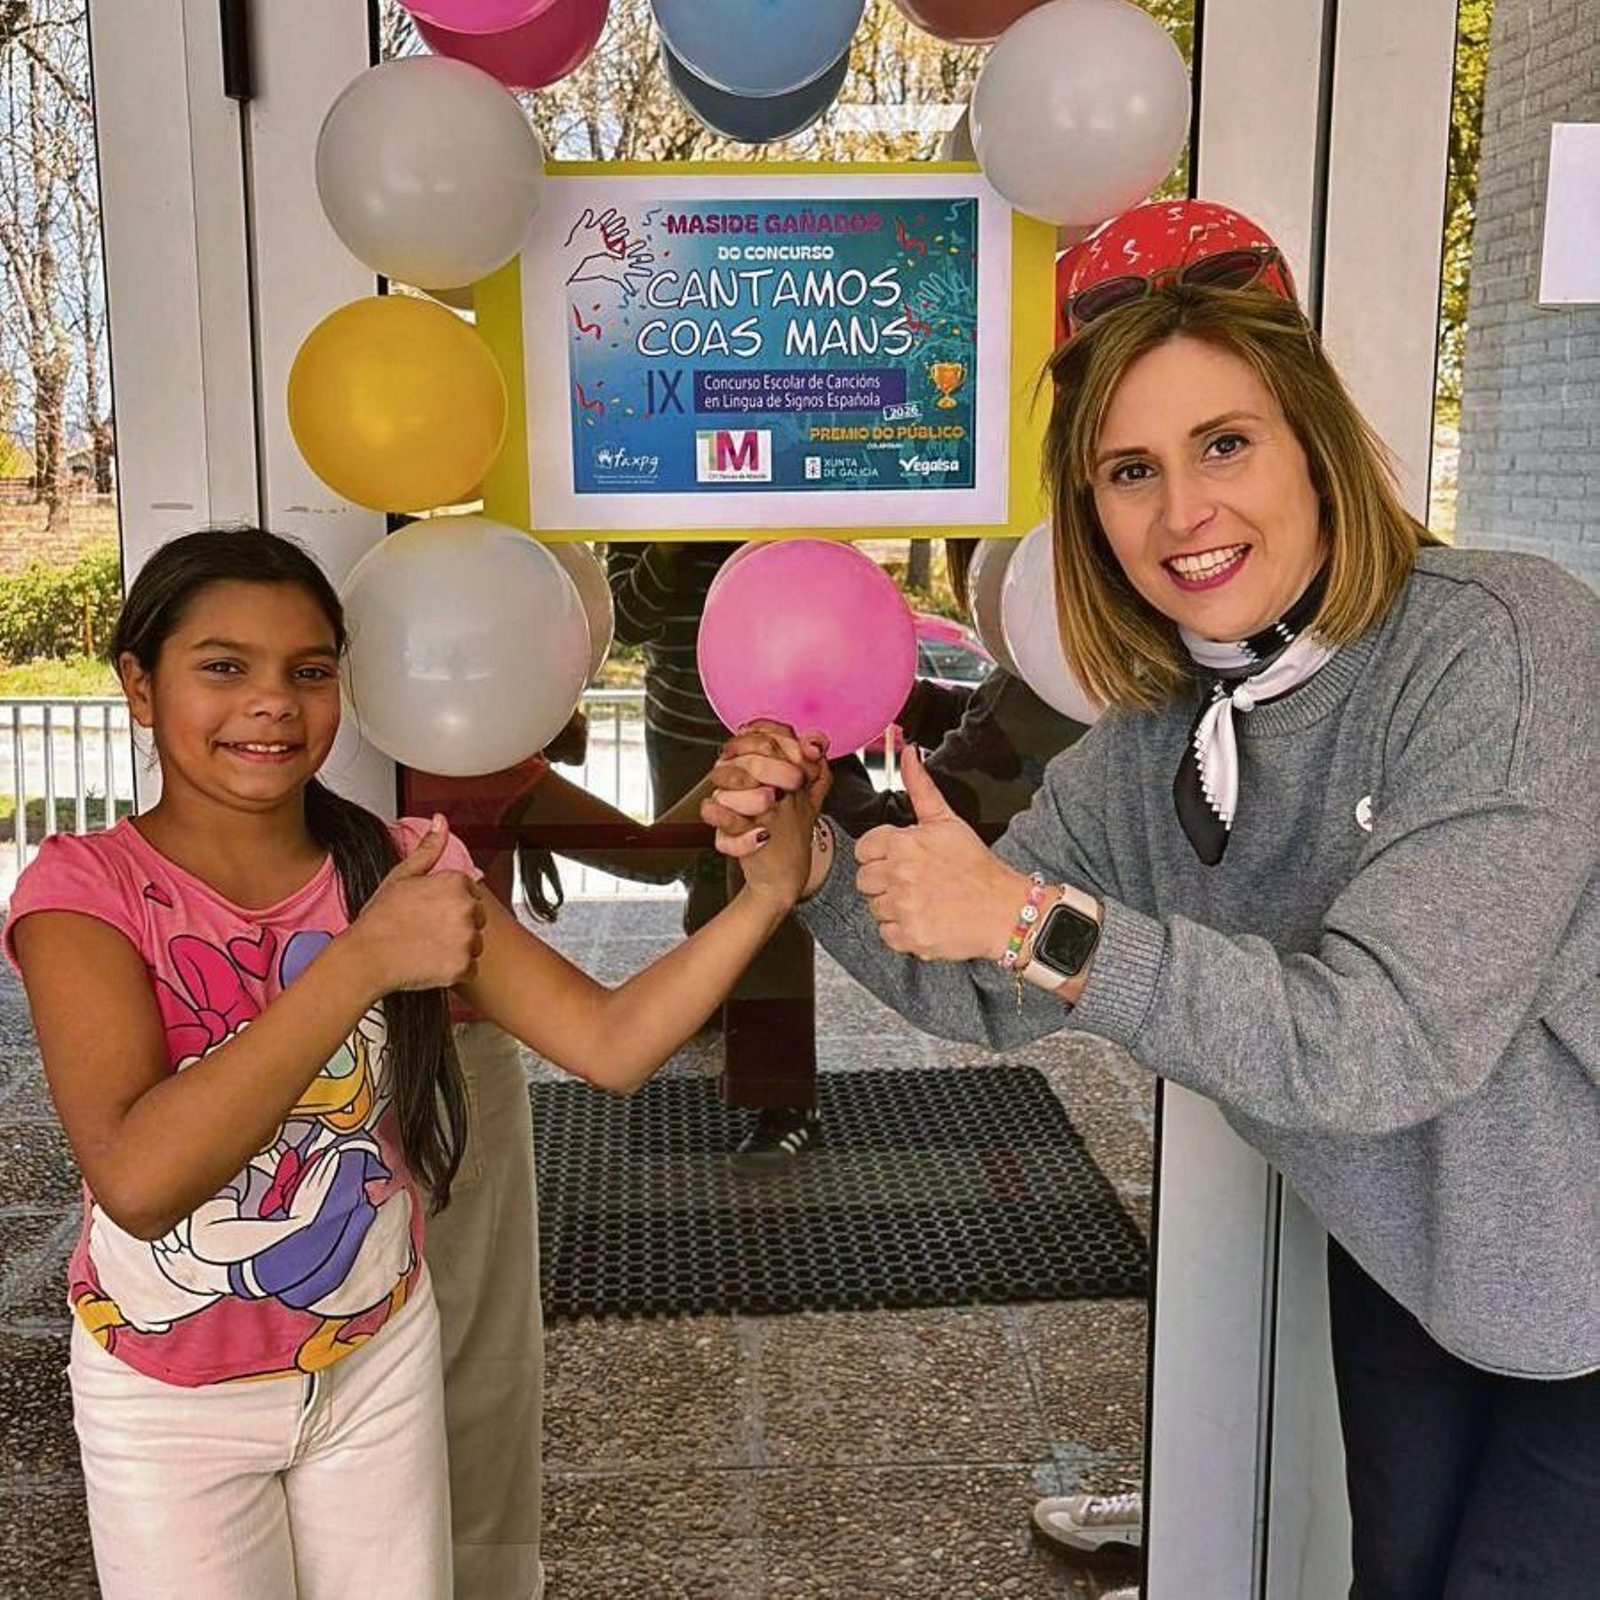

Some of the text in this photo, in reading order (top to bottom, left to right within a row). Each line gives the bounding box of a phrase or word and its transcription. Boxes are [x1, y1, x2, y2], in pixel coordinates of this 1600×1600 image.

[666, 214, 760, 234] MASIDE
[717, 245, 835, 260] DO CONCURSO
[647, 266, 902, 309] CANTAMOS
[637, 315, 914, 357] COAS MANS
[646, 370, 685, 414] IX
[704, 373, 881, 391] Concurso Escolar de Cancións
[704, 396, 720, 409] en
[765, 393, 782, 408] de
[784, 392, 824, 412] Signos
[826, 391, 881, 410] Española
[809, 427, 869, 442] PREMIO
[896, 421, 966, 441] PÚBLICO
[613, 446, 660, 473] faxpg
[823, 458, 858, 467] XUNTA
[823, 468, 879, 478] DE GALICIA
